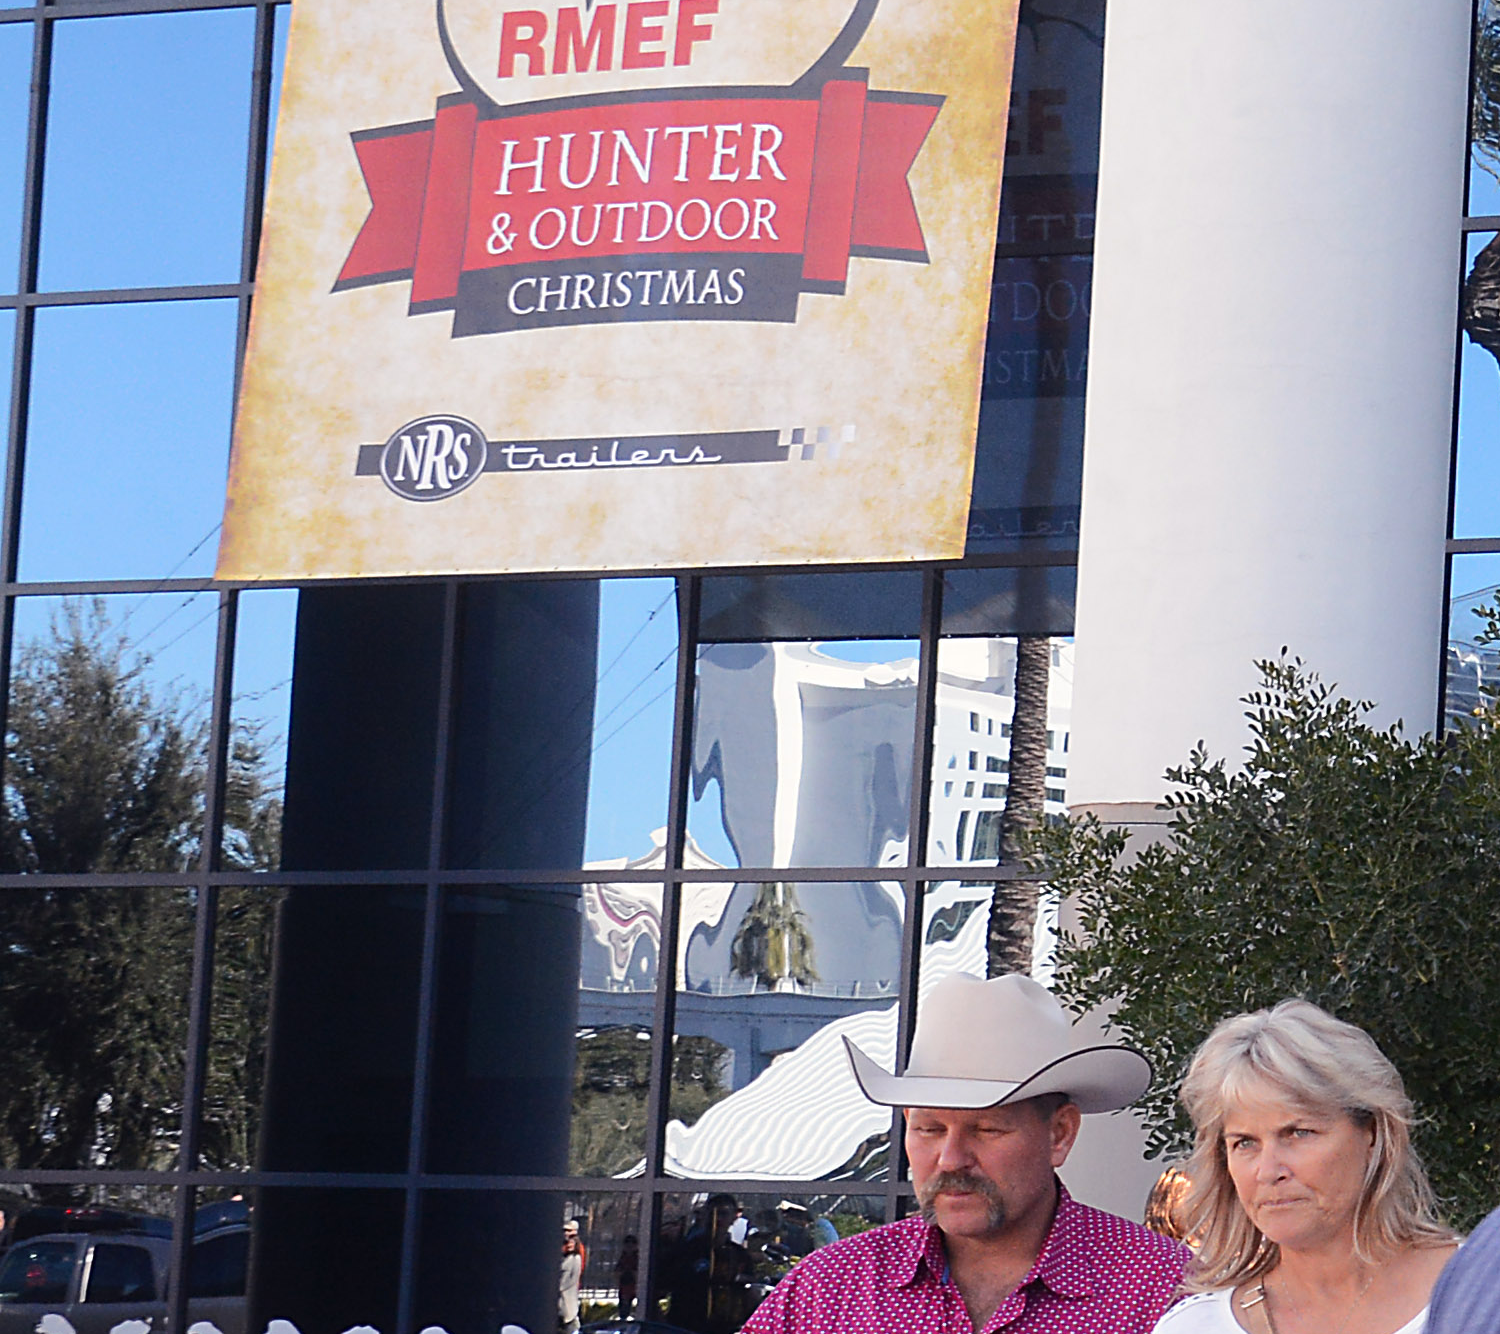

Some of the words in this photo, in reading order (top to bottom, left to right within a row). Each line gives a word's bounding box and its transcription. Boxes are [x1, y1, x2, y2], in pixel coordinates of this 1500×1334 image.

[494, 123, 787, 195] HUNTER
[486, 213, 518, 255] &
[529, 198, 779, 250] OUTDOOR
[508, 268, 746, 315] CHRISTMAS
[394, 424, 471, 490] NRS
[501, 441, 722, 469] trailers
